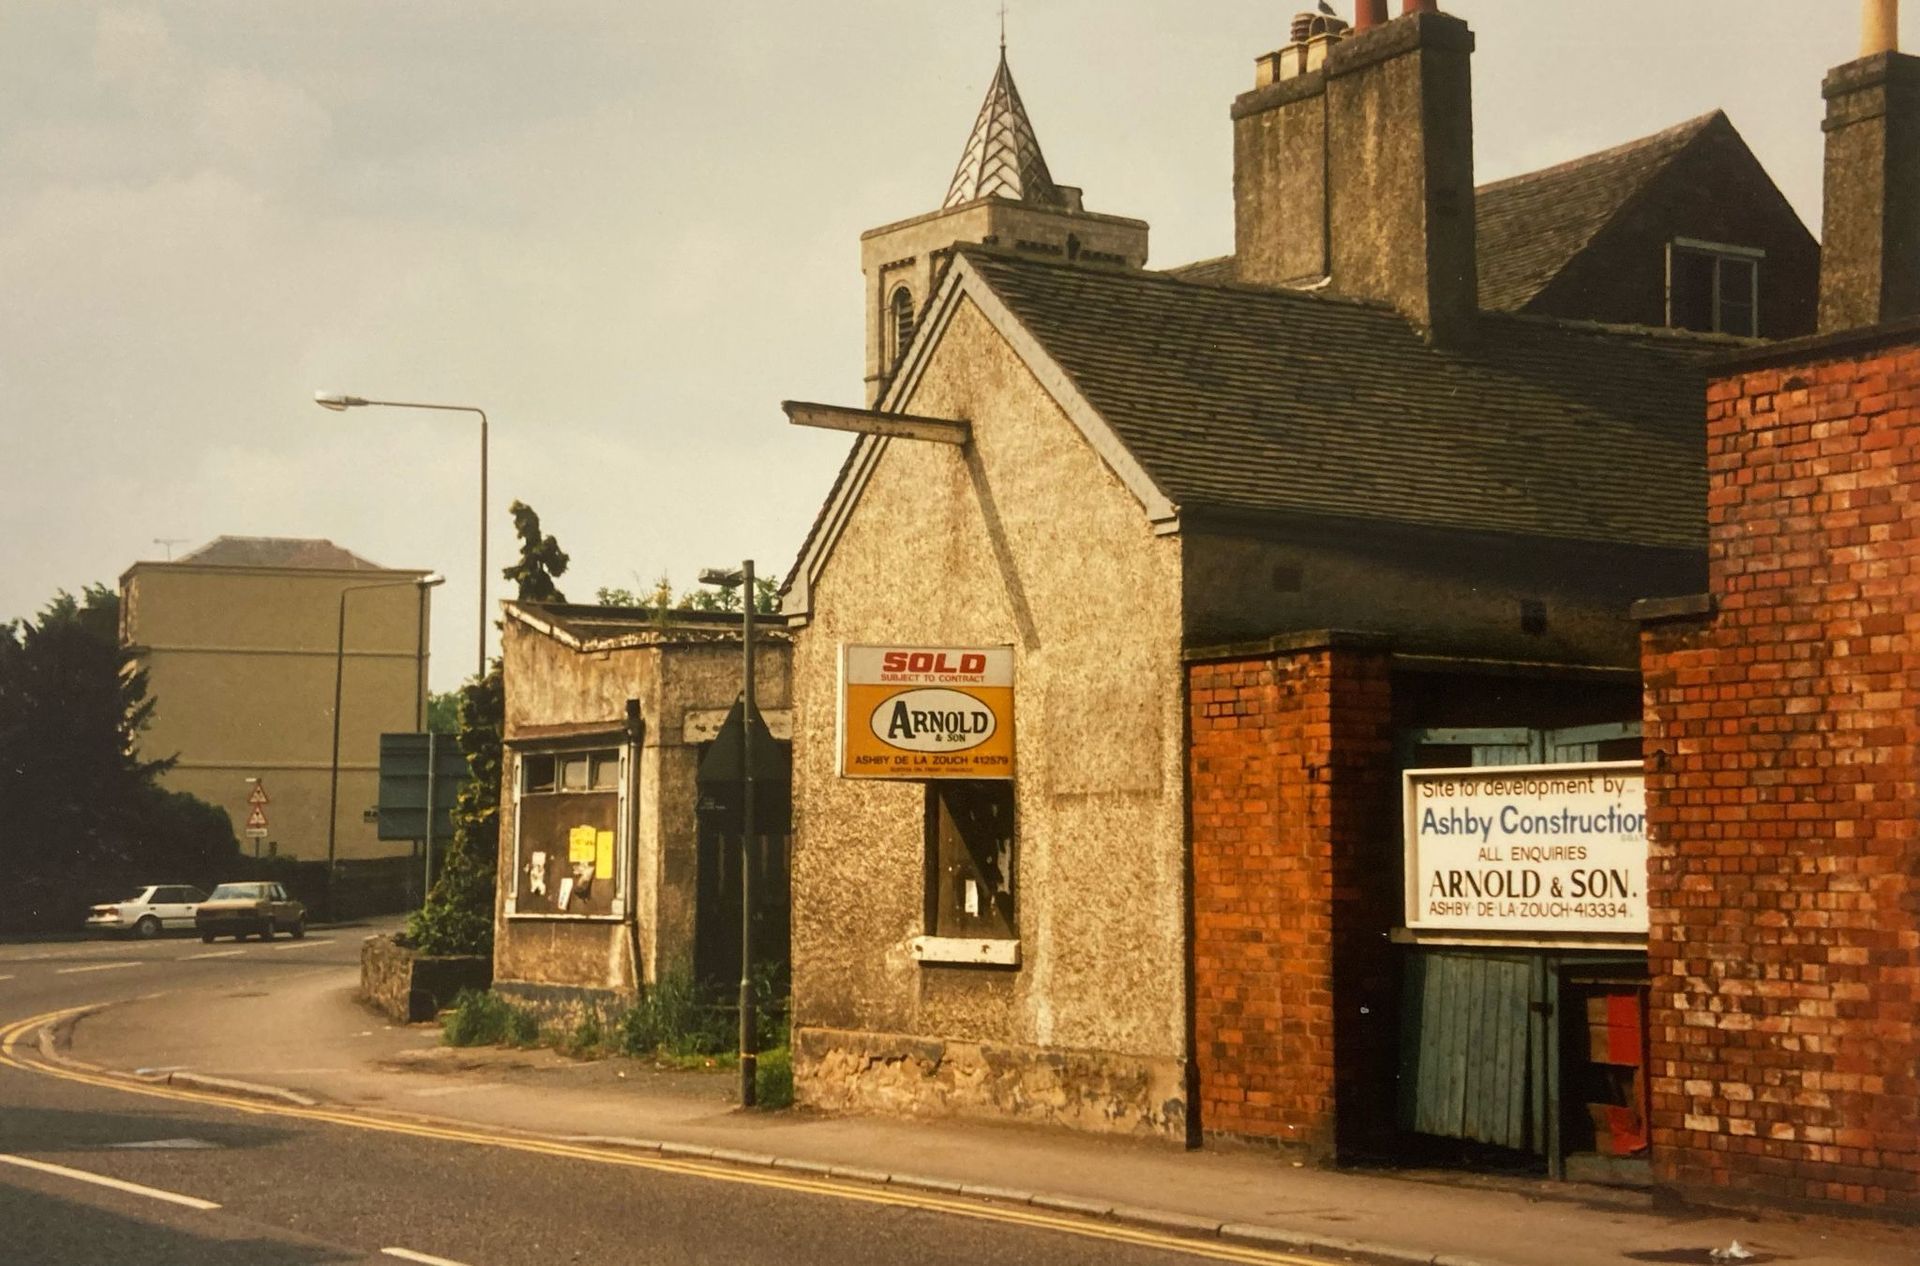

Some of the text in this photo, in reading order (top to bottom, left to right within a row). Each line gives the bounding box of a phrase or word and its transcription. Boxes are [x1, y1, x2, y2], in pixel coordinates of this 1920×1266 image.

[883, 652, 986, 674] SOLD
[881, 673, 985, 683] SUBJECT TO CONTRACT
[887, 701, 988, 739] ARNOLD
[935, 733, 966, 742] & SON
[855, 756, 890, 765] ASHBY
[894, 756, 908, 765] DE
[914, 756, 927, 765] LA
[933, 756, 968, 765] ZOUCH
[1423, 779, 1454, 798] Site
[1460, 778, 1479, 797] for
[1484, 777, 1594, 800] development
[1421, 807, 1493, 843] Ashby
[1478, 846, 1587, 862] ALL ENQUIRIES
[1429, 869, 1541, 898] ARNOLD
[1550, 877, 1563, 898] &
[1429, 901, 1470, 916] ASHBY
[1477, 901, 1494, 916] DE
[1499, 901, 1515, 916] LA
